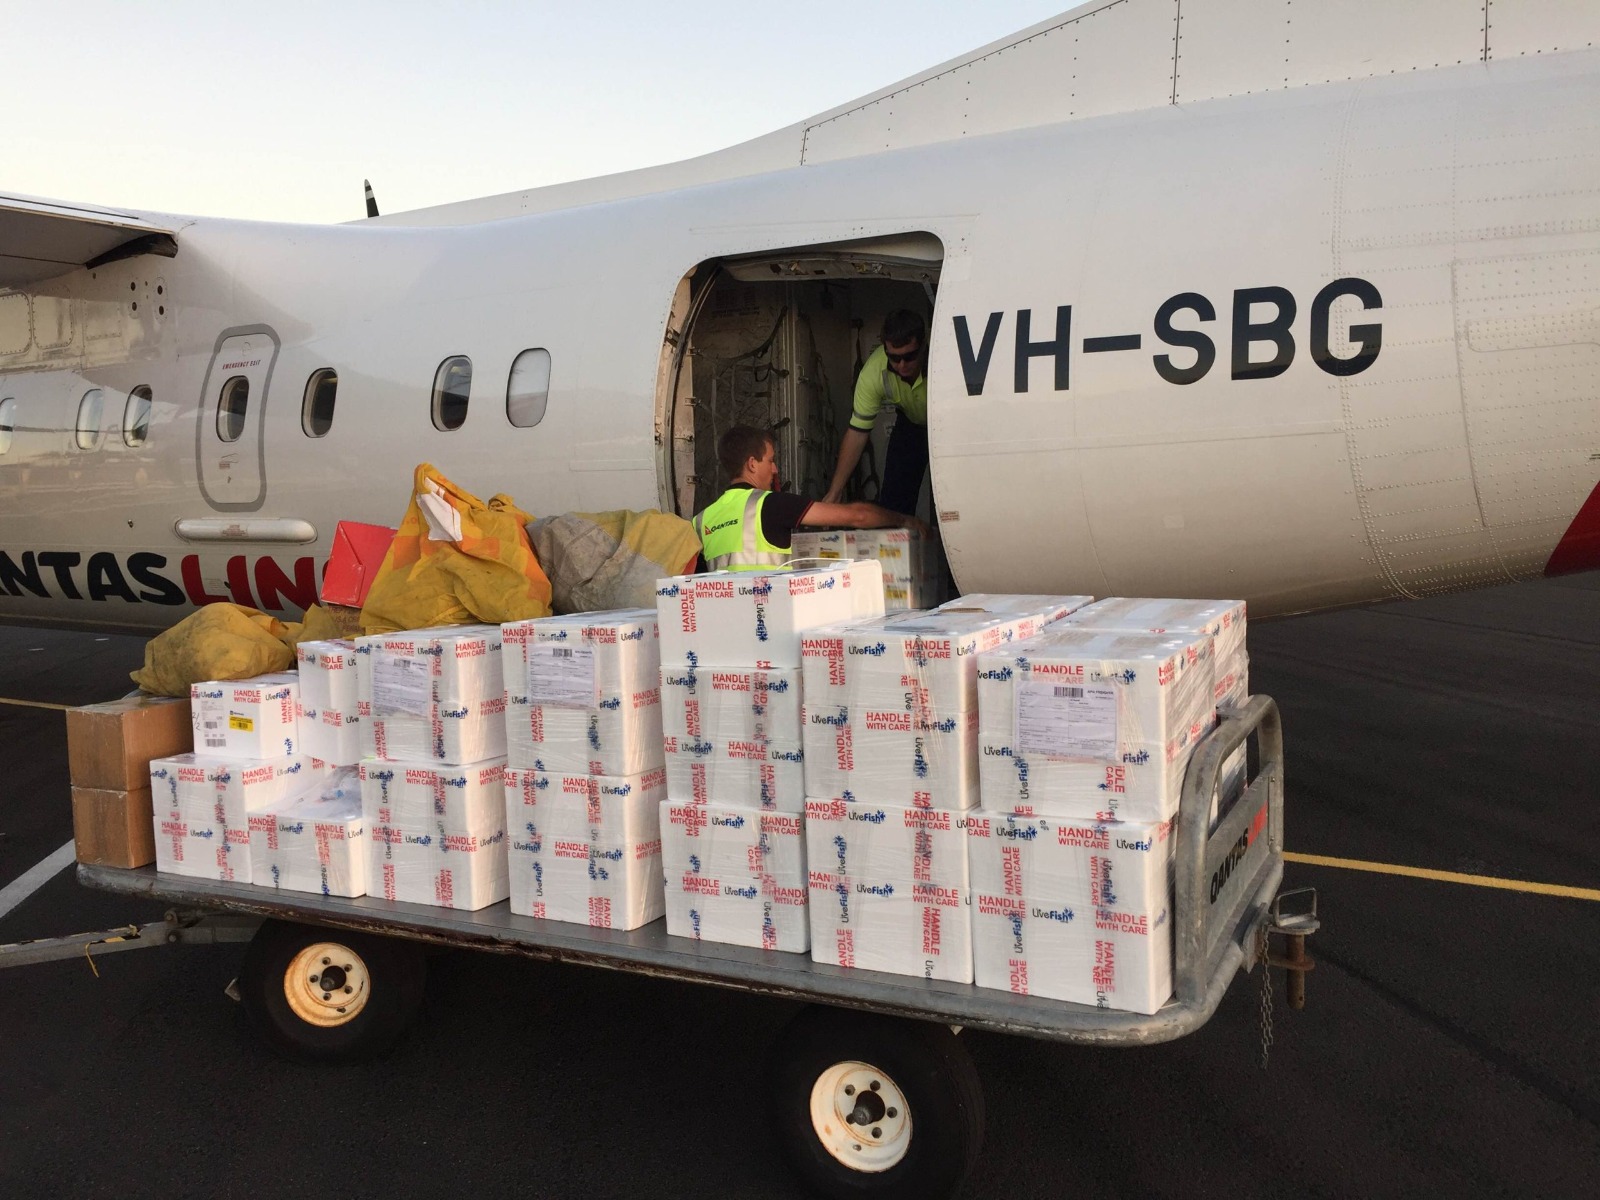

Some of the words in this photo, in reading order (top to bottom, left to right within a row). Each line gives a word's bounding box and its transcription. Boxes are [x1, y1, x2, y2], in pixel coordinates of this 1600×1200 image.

[953, 277, 1383, 396] VH-SBG
[222, 361, 249, 370] EMERGENCY
[0, 551, 334, 612] NTASLIN
[696, 581, 734, 591] HANDLE
[789, 576, 815, 589] HANDLE
[696, 590, 713, 598] WITH
[715, 590, 735, 598] CARE
[739, 586, 768, 597] LiveFish
[681, 588, 690, 633] HANDLE
[757, 602, 766, 637] LiveFish
[502, 628, 534, 638] HANDLE
[581, 628, 616, 638] HANDLE
[621, 630, 642, 641] LiveFish
[503, 636, 519, 644] WITH
[801, 639, 843, 649] HANDLE
[905, 640, 951, 651] HANDLE
[385, 642, 414, 651] HANDLE
[456, 640, 486, 652] HANDLE
[848, 645, 881, 656] LiveFish
[456, 650, 471, 659] WITH
[472, 647, 487, 656] CARE
[802, 649, 820, 657] WITH
[905, 650, 926, 659] WITH
[928, 651, 951, 659] CARE
[1033, 665, 1084, 675] HANDLE
[712, 673, 750, 684] HANDLE
[712, 682, 730, 691] WITH
[731, 683, 750, 693] CARE
[234, 690, 261, 698] HANDLE
[633, 688, 659, 701] HANDLE
[600, 698, 616, 709] eFish
[442, 709, 465, 719] LiveFish
[685, 700, 694, 737] ANDLE
[811, 714, 842, 725] LiveFish
[866, 712, 911, 723] HANDLE
[866, 722, 888, 731] WITH
[889, 722, 911, 732] CARE
[728, 741, 767, 753] HANDLE
[836, 726, 846, 771] HANDLE
[984, 745, 1013, 757] LiveFis
[728, 749, 746, 758] WITH
[747, 752, 767, 761] CARE
[771, 751, 801, 762] LiveFish
[1123, 752, 1144, 764] Fish
[178, 769, 204, 777] HANDLE
[242, 767, 273, 779] HANDLE
[406, 769, 438, 780] HANDLE
[480, 764, 507, 778] HANDLE
[243, 778, 258, 786] WITH
[259, 775, 273, 783] CARE
[407, 777, 421, 785] WITH
[563, 778, 597, 788] HANDLE
[691, 763, 701, 804] HANDLE
[1019, 761, 1029, 800] LiveFish
[601, 785, 628, 796] LiveFish
[848, 812, 880, 824] LiveFish
[904, 809, 950, 822] HANDLE
[711, 817, 741, 828] LiveFish
[761, 816, 800, 829] HANDLE
[904, 819, 926, 828] WITH
[927, 821, 951, 830] CARE
[968, 818, 990, 829] DLE
[315, 824, 345, 835] HANDLE
[780, 827, 800, 836] CARE
[996, 827, 1031, 840] LiveFish
[1058, 826, 1110, 841] HANDLE
[406, 836, 430, 846] LiveFish
[445, 836, 477, 846] HANDLE
[555, 841, 589, 852] HANDLE
[1058, 837, 1081, 847] WITH
[1084, 839, 1110, 850] CARE
[461, 845, 477, 853] CARE
[555, 850, 571, 858] WITH
[572, 851, 589, 860] CARE
[837, 842, 846, 874] LiveFish
[1002, 846, 1013, 895] HANDLE
[1091, 855, 1099, 880] WITH
[683, 877, 720, 888] HANDLE
[809, 881, 828, 890] WITH
[1014, 874, 1022, 896] WITH
[701, 887, 720, 896] CARE
[724, 887, 754, 899] LiveFish
[857, 884, 889, 896] LiveFish
[913, 885, 959, 899] HANDLE
[1091, 881, 1099, 907] CARE
[913, 894, 934, 904] WITH
[935, 896, 960, 907] CARE
[979, 895, 1025, 911] HANDLE
[840, 890, 849, 923] LiveFish
[979, 905, 1001, 915] WITH
[923, 906, 931, 929] WITH
[1032, 907, 1069, 922] LiveFish
[1096, 909, 1147, 926] HANDLE
[931, 908, 940, 955] HANDLE
[1095, 921, 1118, 932] WITH
[1120, 923, 1147, 936] CARE
[846, 929, 855, 951] CARE
[922, 930, 931, 953] CARE
[1009, 960, 1019, 995] NDLE
[1018, 961, 1028, 986] CARE
